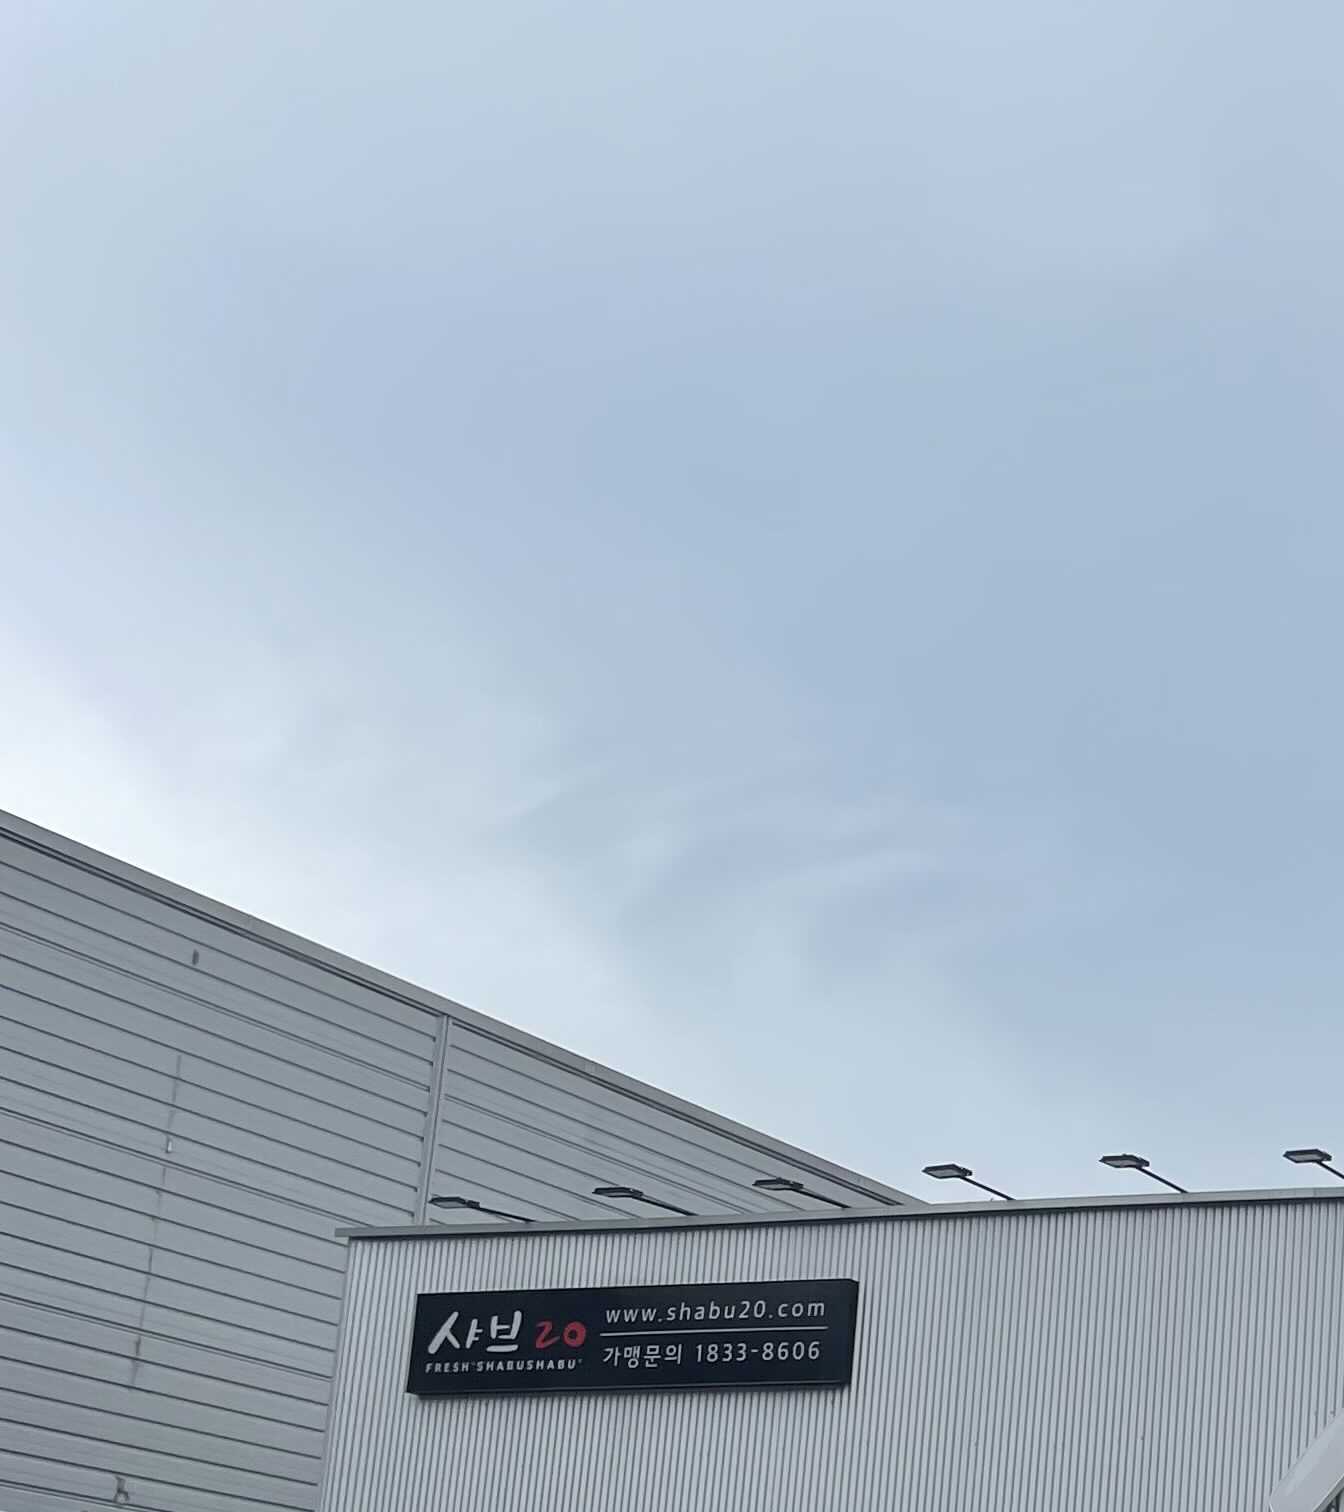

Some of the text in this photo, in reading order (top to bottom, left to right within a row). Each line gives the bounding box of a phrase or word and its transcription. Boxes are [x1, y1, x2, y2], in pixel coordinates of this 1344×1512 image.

[606, 1300, 825, 1323] www.shabu20.com
[602, 1341, 821, 1369] 가맹문의 1833-8606
